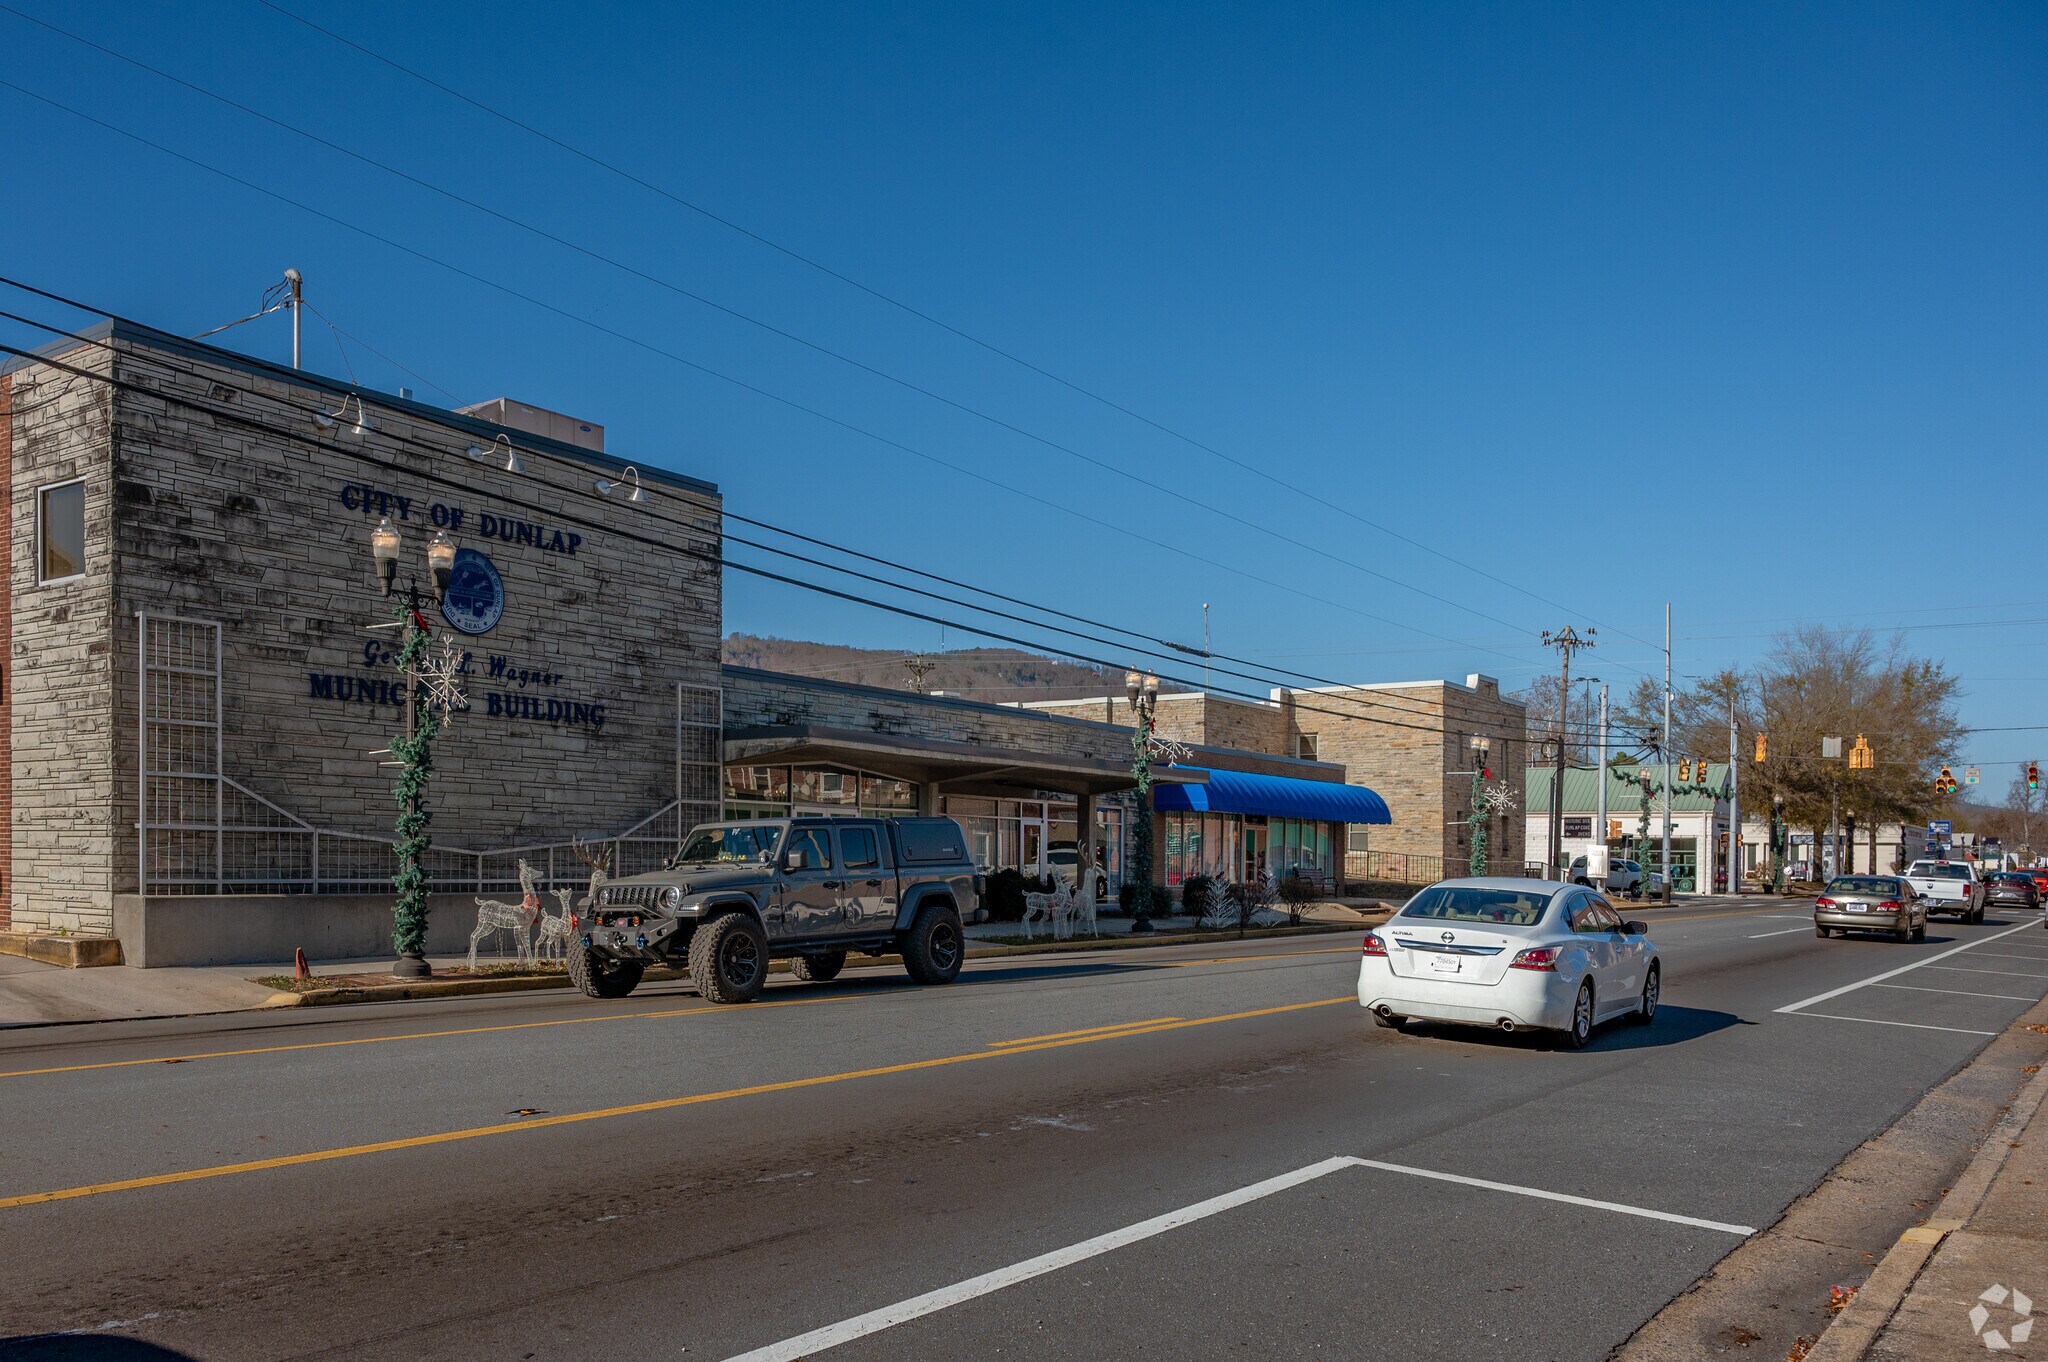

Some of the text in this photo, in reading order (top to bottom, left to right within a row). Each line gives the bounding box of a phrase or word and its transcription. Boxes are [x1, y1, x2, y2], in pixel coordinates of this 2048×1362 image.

[341, 485, 582, 554] CITY OF DUNLAP
[488, 655, 563, 689] Wagner
[487, 692, 605, 726] BUILDING
